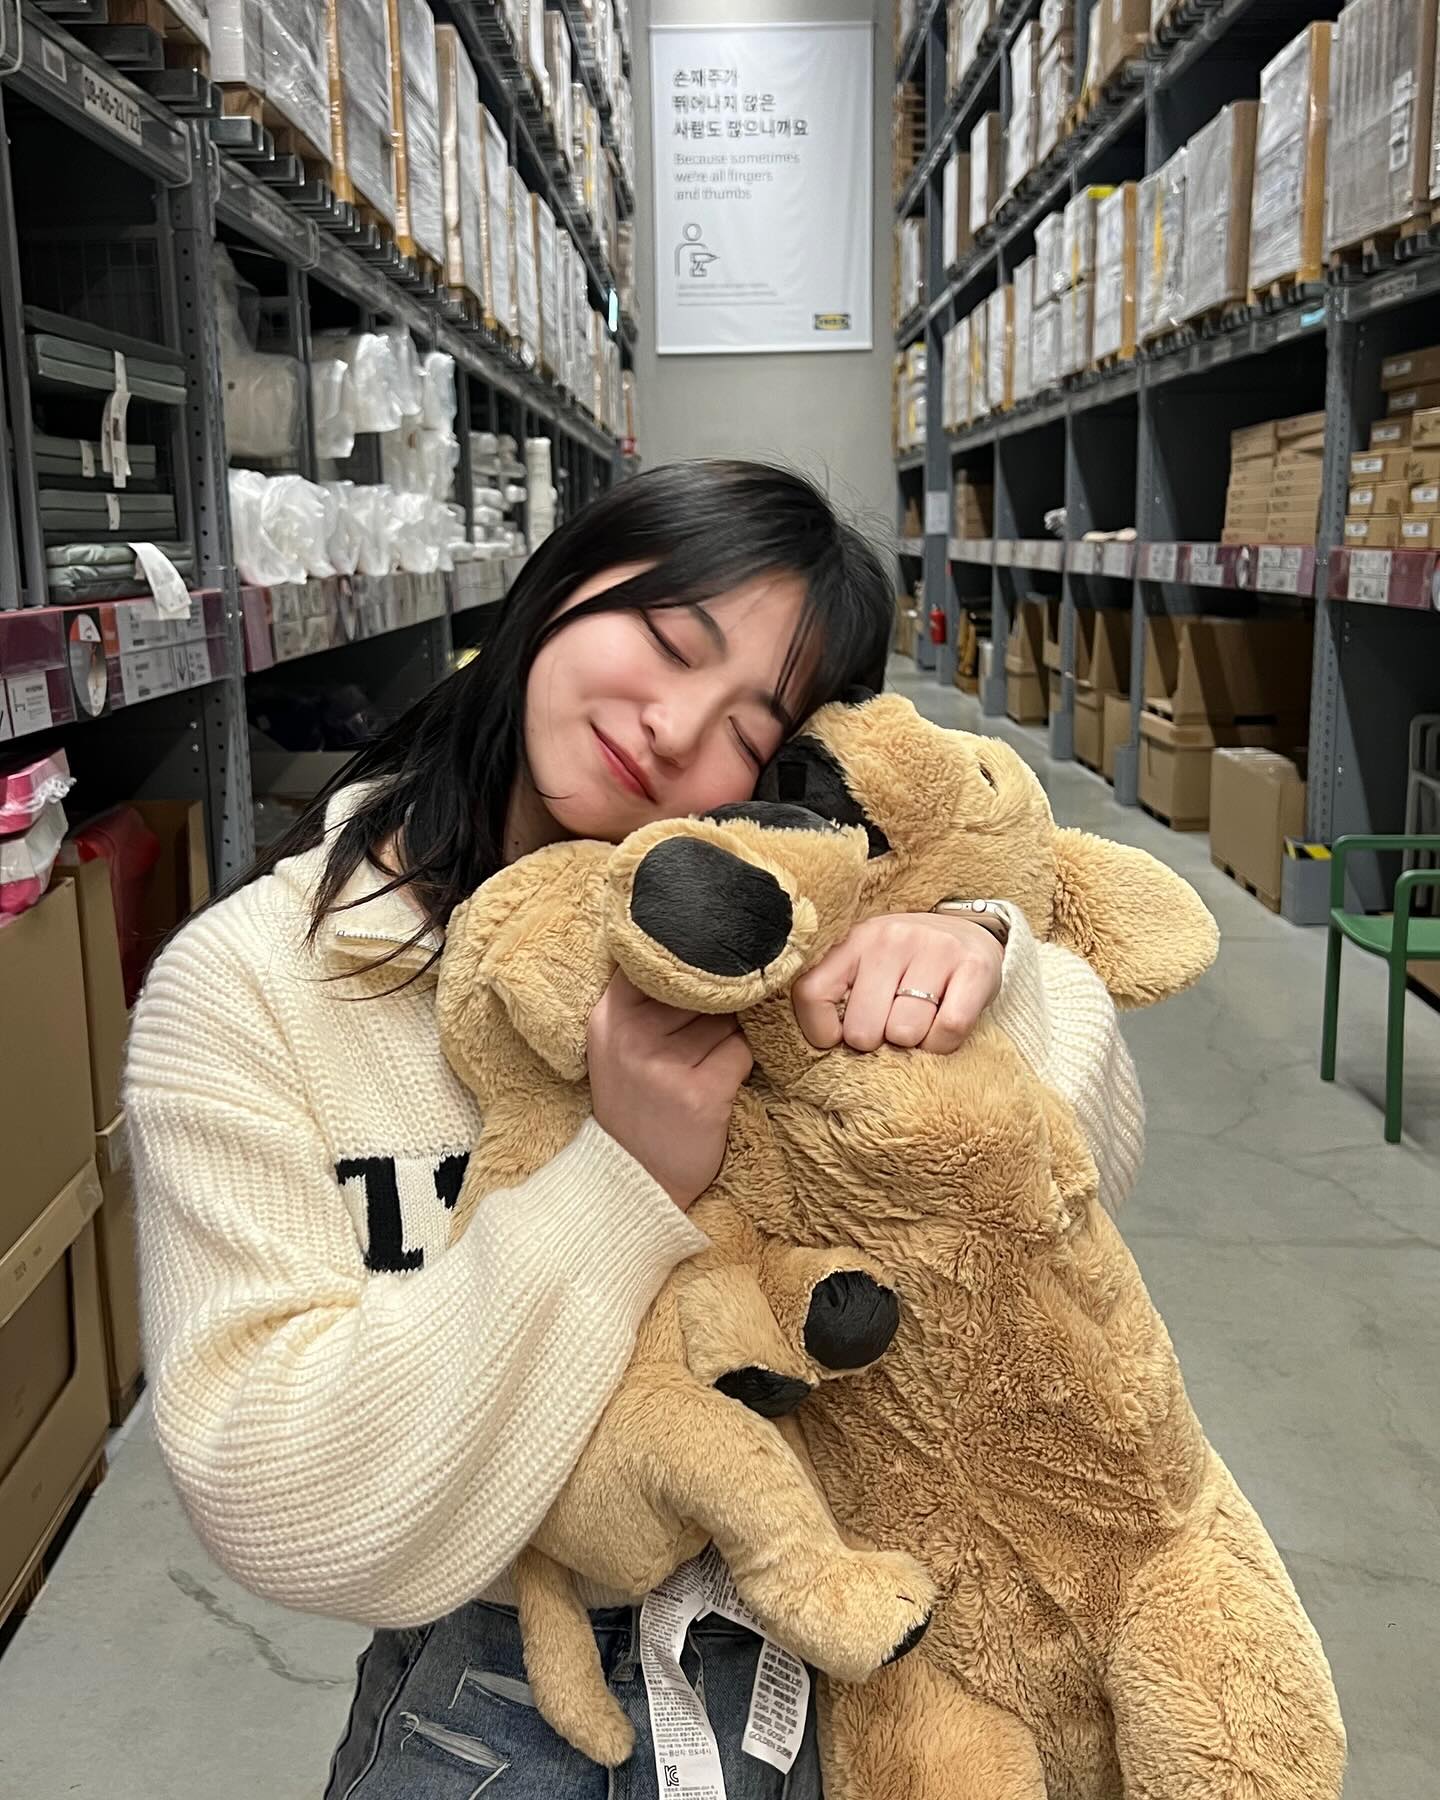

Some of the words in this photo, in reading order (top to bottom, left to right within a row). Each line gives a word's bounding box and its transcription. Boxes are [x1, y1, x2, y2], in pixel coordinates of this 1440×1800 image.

[674, 69, 738, 87] 손재주가
[673, 94, 737, 113] 뛰어나지
[744, 93, 775, 112] 않은
[674, 119, 722, 140] 사람도
[728, 117, 809, 138] 많으니까요
[674, 152, 727, 165] Because
[731, 152, 801, 164] sometimes
[710, 169, 726, 181] all
[727, 169, 773, 184] fingers
[675, 188, 700, 200] and
[702, 188, 752, 200] thumbs
